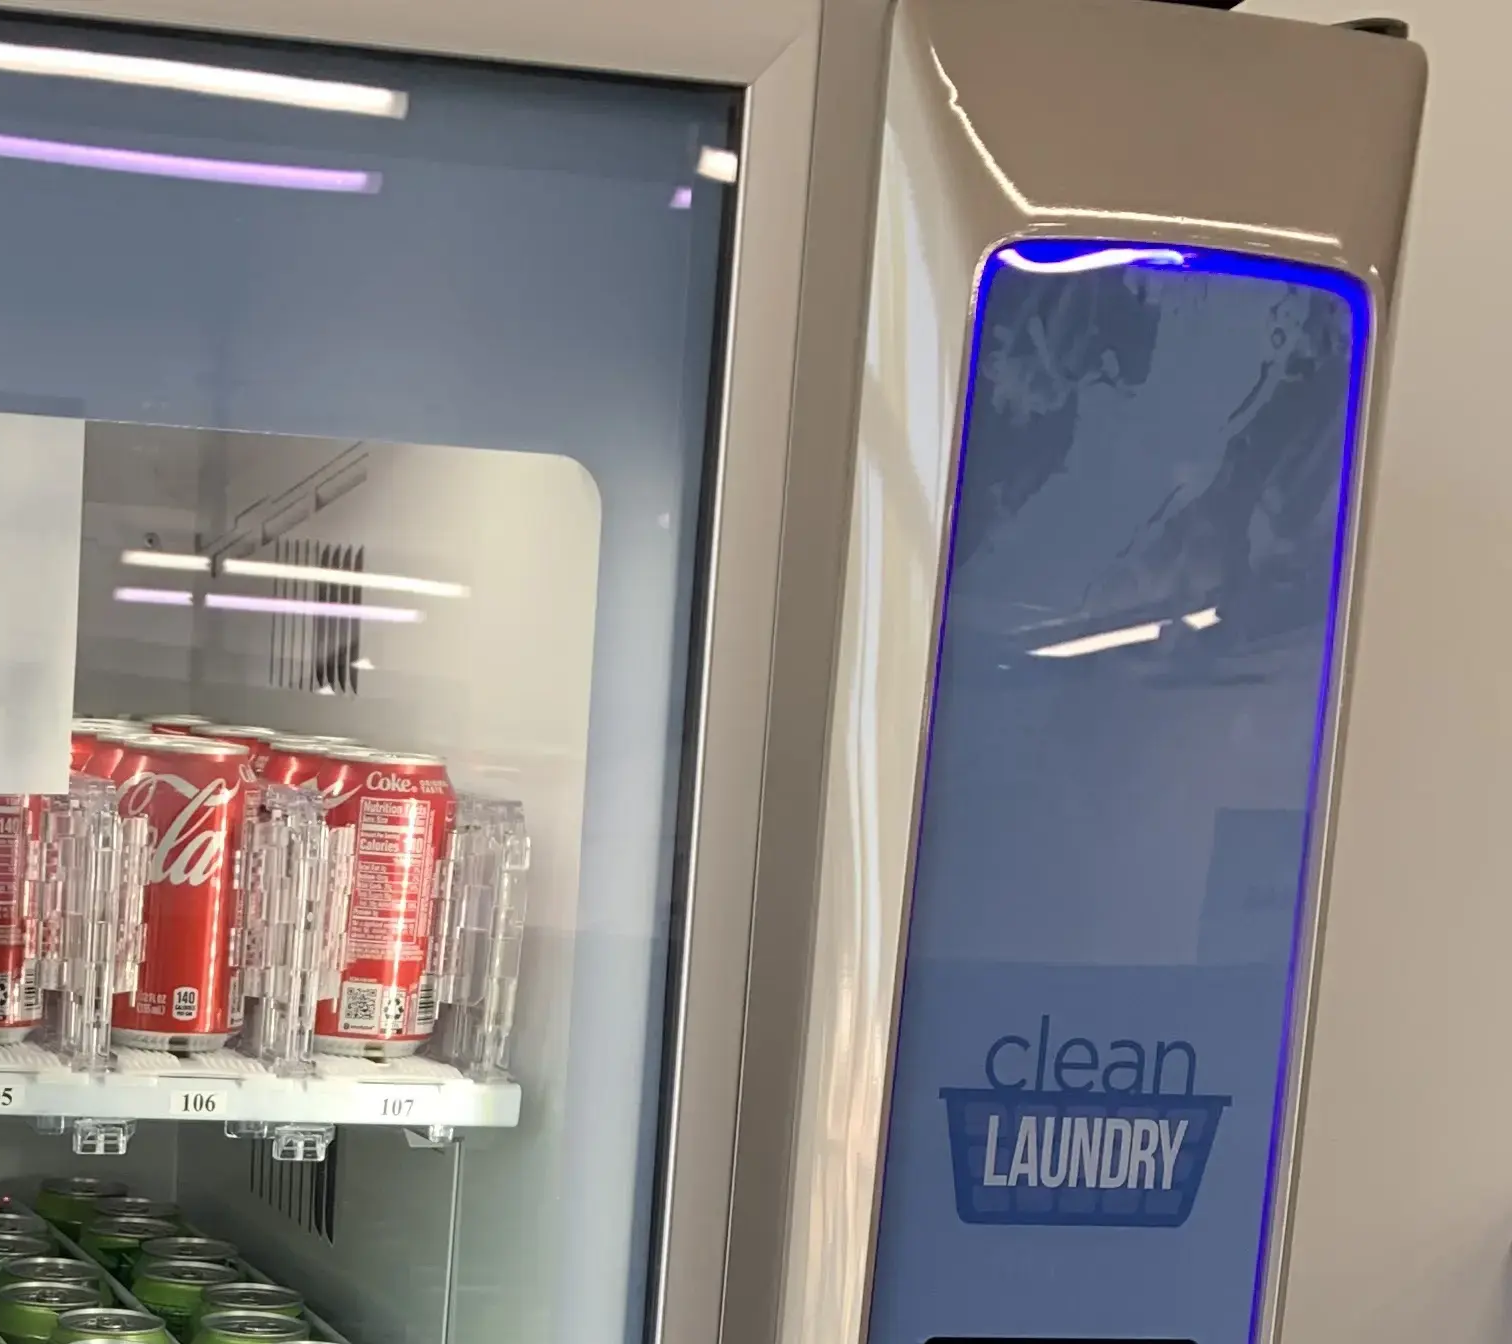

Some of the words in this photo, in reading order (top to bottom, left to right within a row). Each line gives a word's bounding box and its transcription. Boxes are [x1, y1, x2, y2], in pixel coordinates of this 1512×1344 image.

[366, 771, 412, 793] Coke
[177, 991, 196, 1005] 140
[985, 1014, 1197, 1097] clean
[181, 1092, 217, 1112] 106
[380, 1097, 415, 1117] 107
[983, 1115, 1189, 1190] LAUNDRY
